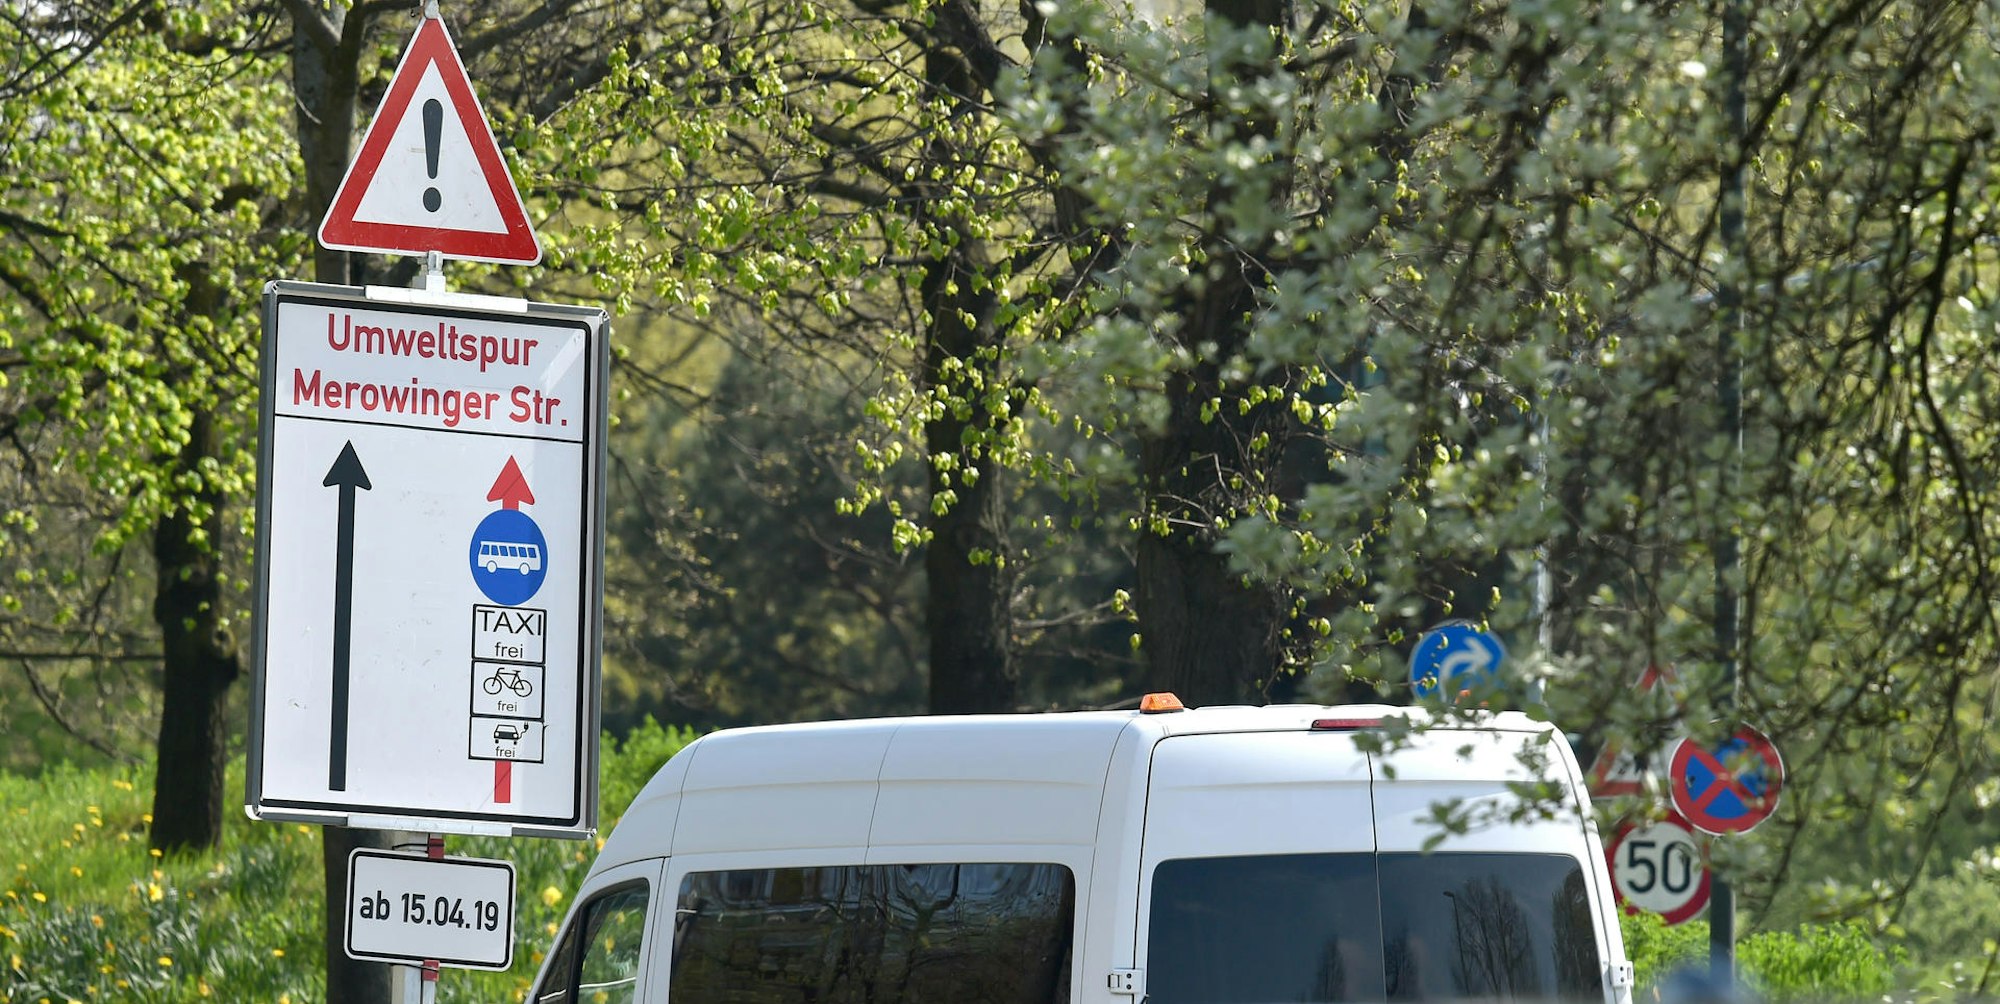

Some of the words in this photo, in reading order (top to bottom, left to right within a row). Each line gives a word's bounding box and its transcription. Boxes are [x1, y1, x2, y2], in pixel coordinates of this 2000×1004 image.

[328, 313, 538, 373] Umweltspur
[293, 368, 500, 427] Merowinger
[509, 385, 567, 426] Str.
[477, 609, 541, 635] TAXI
[495, 641, 523, 659] frei
[497, 700, 518, 712] frei
[495, 746, 516, 758] frei
[1627, 840, 1691, 894] 50
[360, 890, 390, 920] ab
[401, 893, 499, 931] 15.04.19
